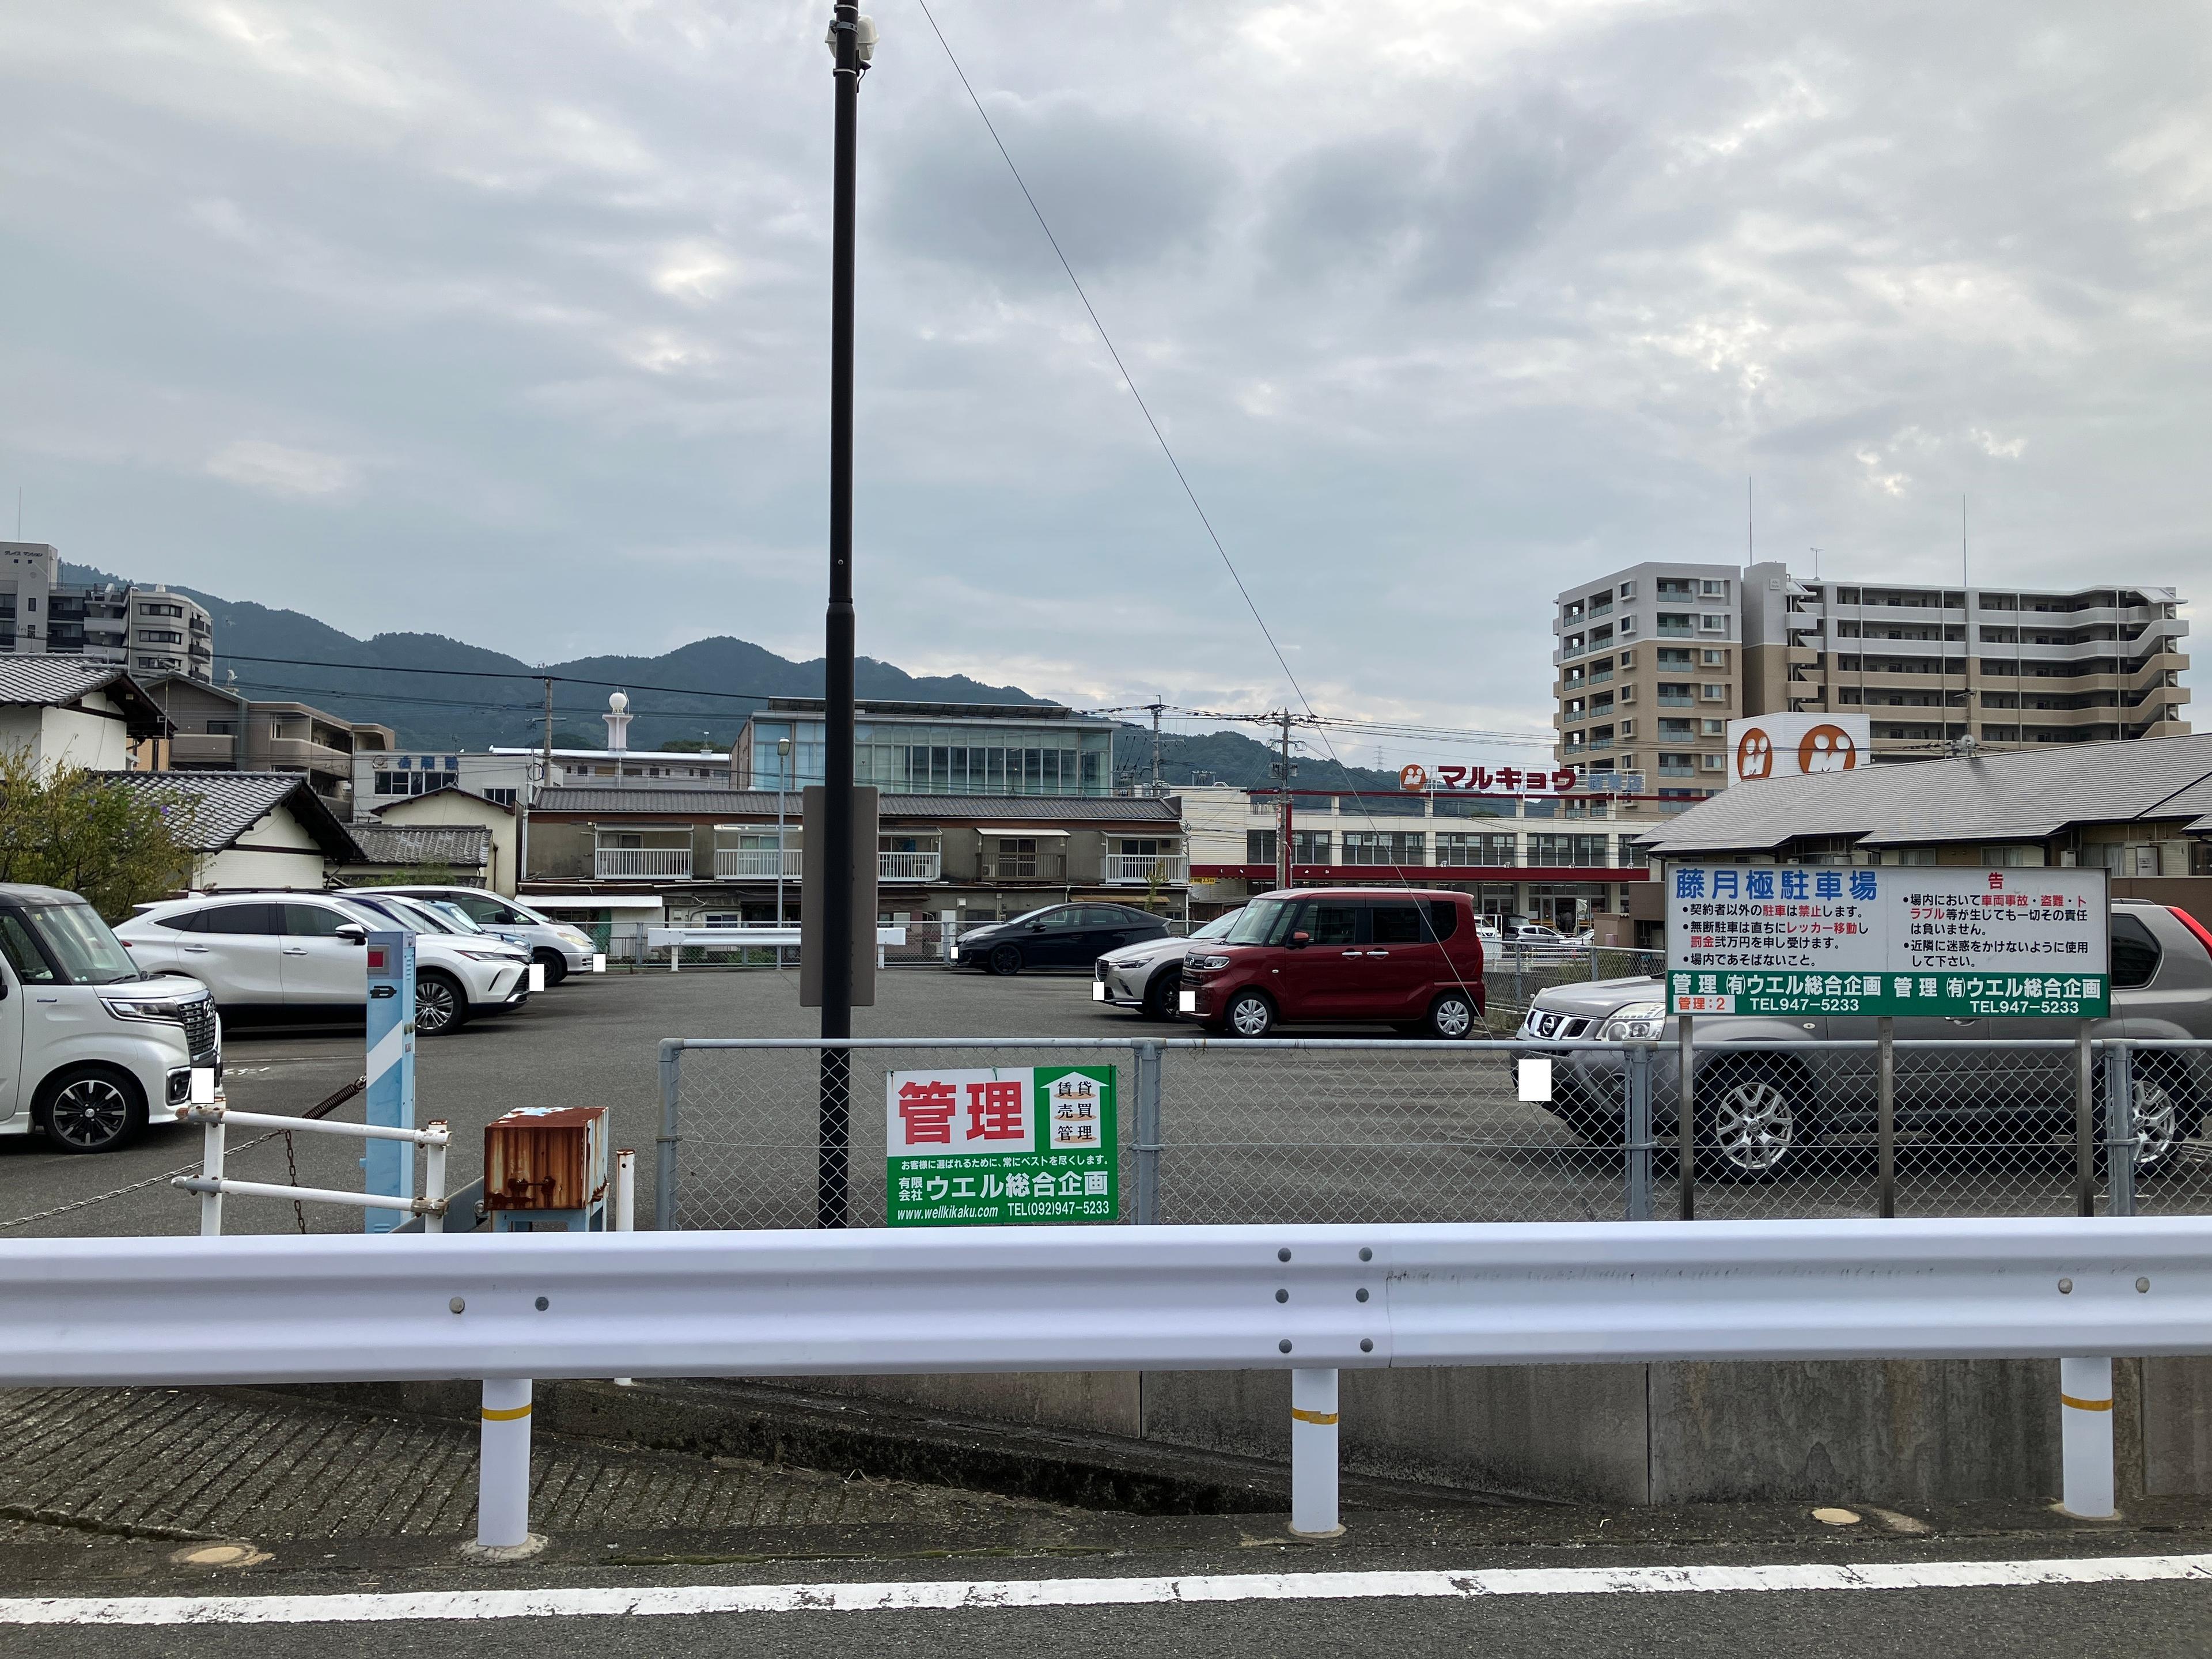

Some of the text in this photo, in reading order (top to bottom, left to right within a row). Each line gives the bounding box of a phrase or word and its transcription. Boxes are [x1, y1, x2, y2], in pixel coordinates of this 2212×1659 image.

[1438, 766, 1576, 790] マルキョウ
[1676, 868, 1877, 901] 藤月極駐車場
[1988, 872, 2003, 890] 告
[1910, 893, 2086, 907] 場内において車両事故・盗難・ト
[1690, 903, 1862, 918] 契約者以外の駐車は禁止します。
[1910, 907, 2088, 921] ラブル等が生じても一切その責任
[1690, 921, 1869, 935] 無断駐車は直ちにレッカー移動し
[1911, 923, 1987, 936] は負いません。
[1691, 935, 1839, 949] 罰金弐万円を申し受けます。
[1911, 940, 2088, 953] 近隣に迷惑をかけないように使用
[1691, 953, 1816, 967] 場内であそばないこと。
[1912, 955, 1975, 968] して下さい。
[1678, 997, 1725, 1010] 管理：2
[1750, 998, 1859, 1012] TEL947-5233
[1970, 1001, 2079, 1014] TEL947-5233
[1058, 1081, 1092, 1097] 賃貸
[898, 1081, 1024, 1145] 管理
[1058, 1103, 1092, 1119] 売買
[1058, 1125, 1093, 1142] 管理
[902, 1154, 1108, 1171] お客様に選ばれるために、常にベストを尽くします。
[899, 1177, 923, 1189] 有限
[926, 1171, 1108, 1200] ウエル総合企画
[899, 1190, 923, 1202] 会社
[897, 1205, 998, 1220] www.wellkikaku.com
[1007, 1200, 1109, 1217] TEL(092)947-5233
